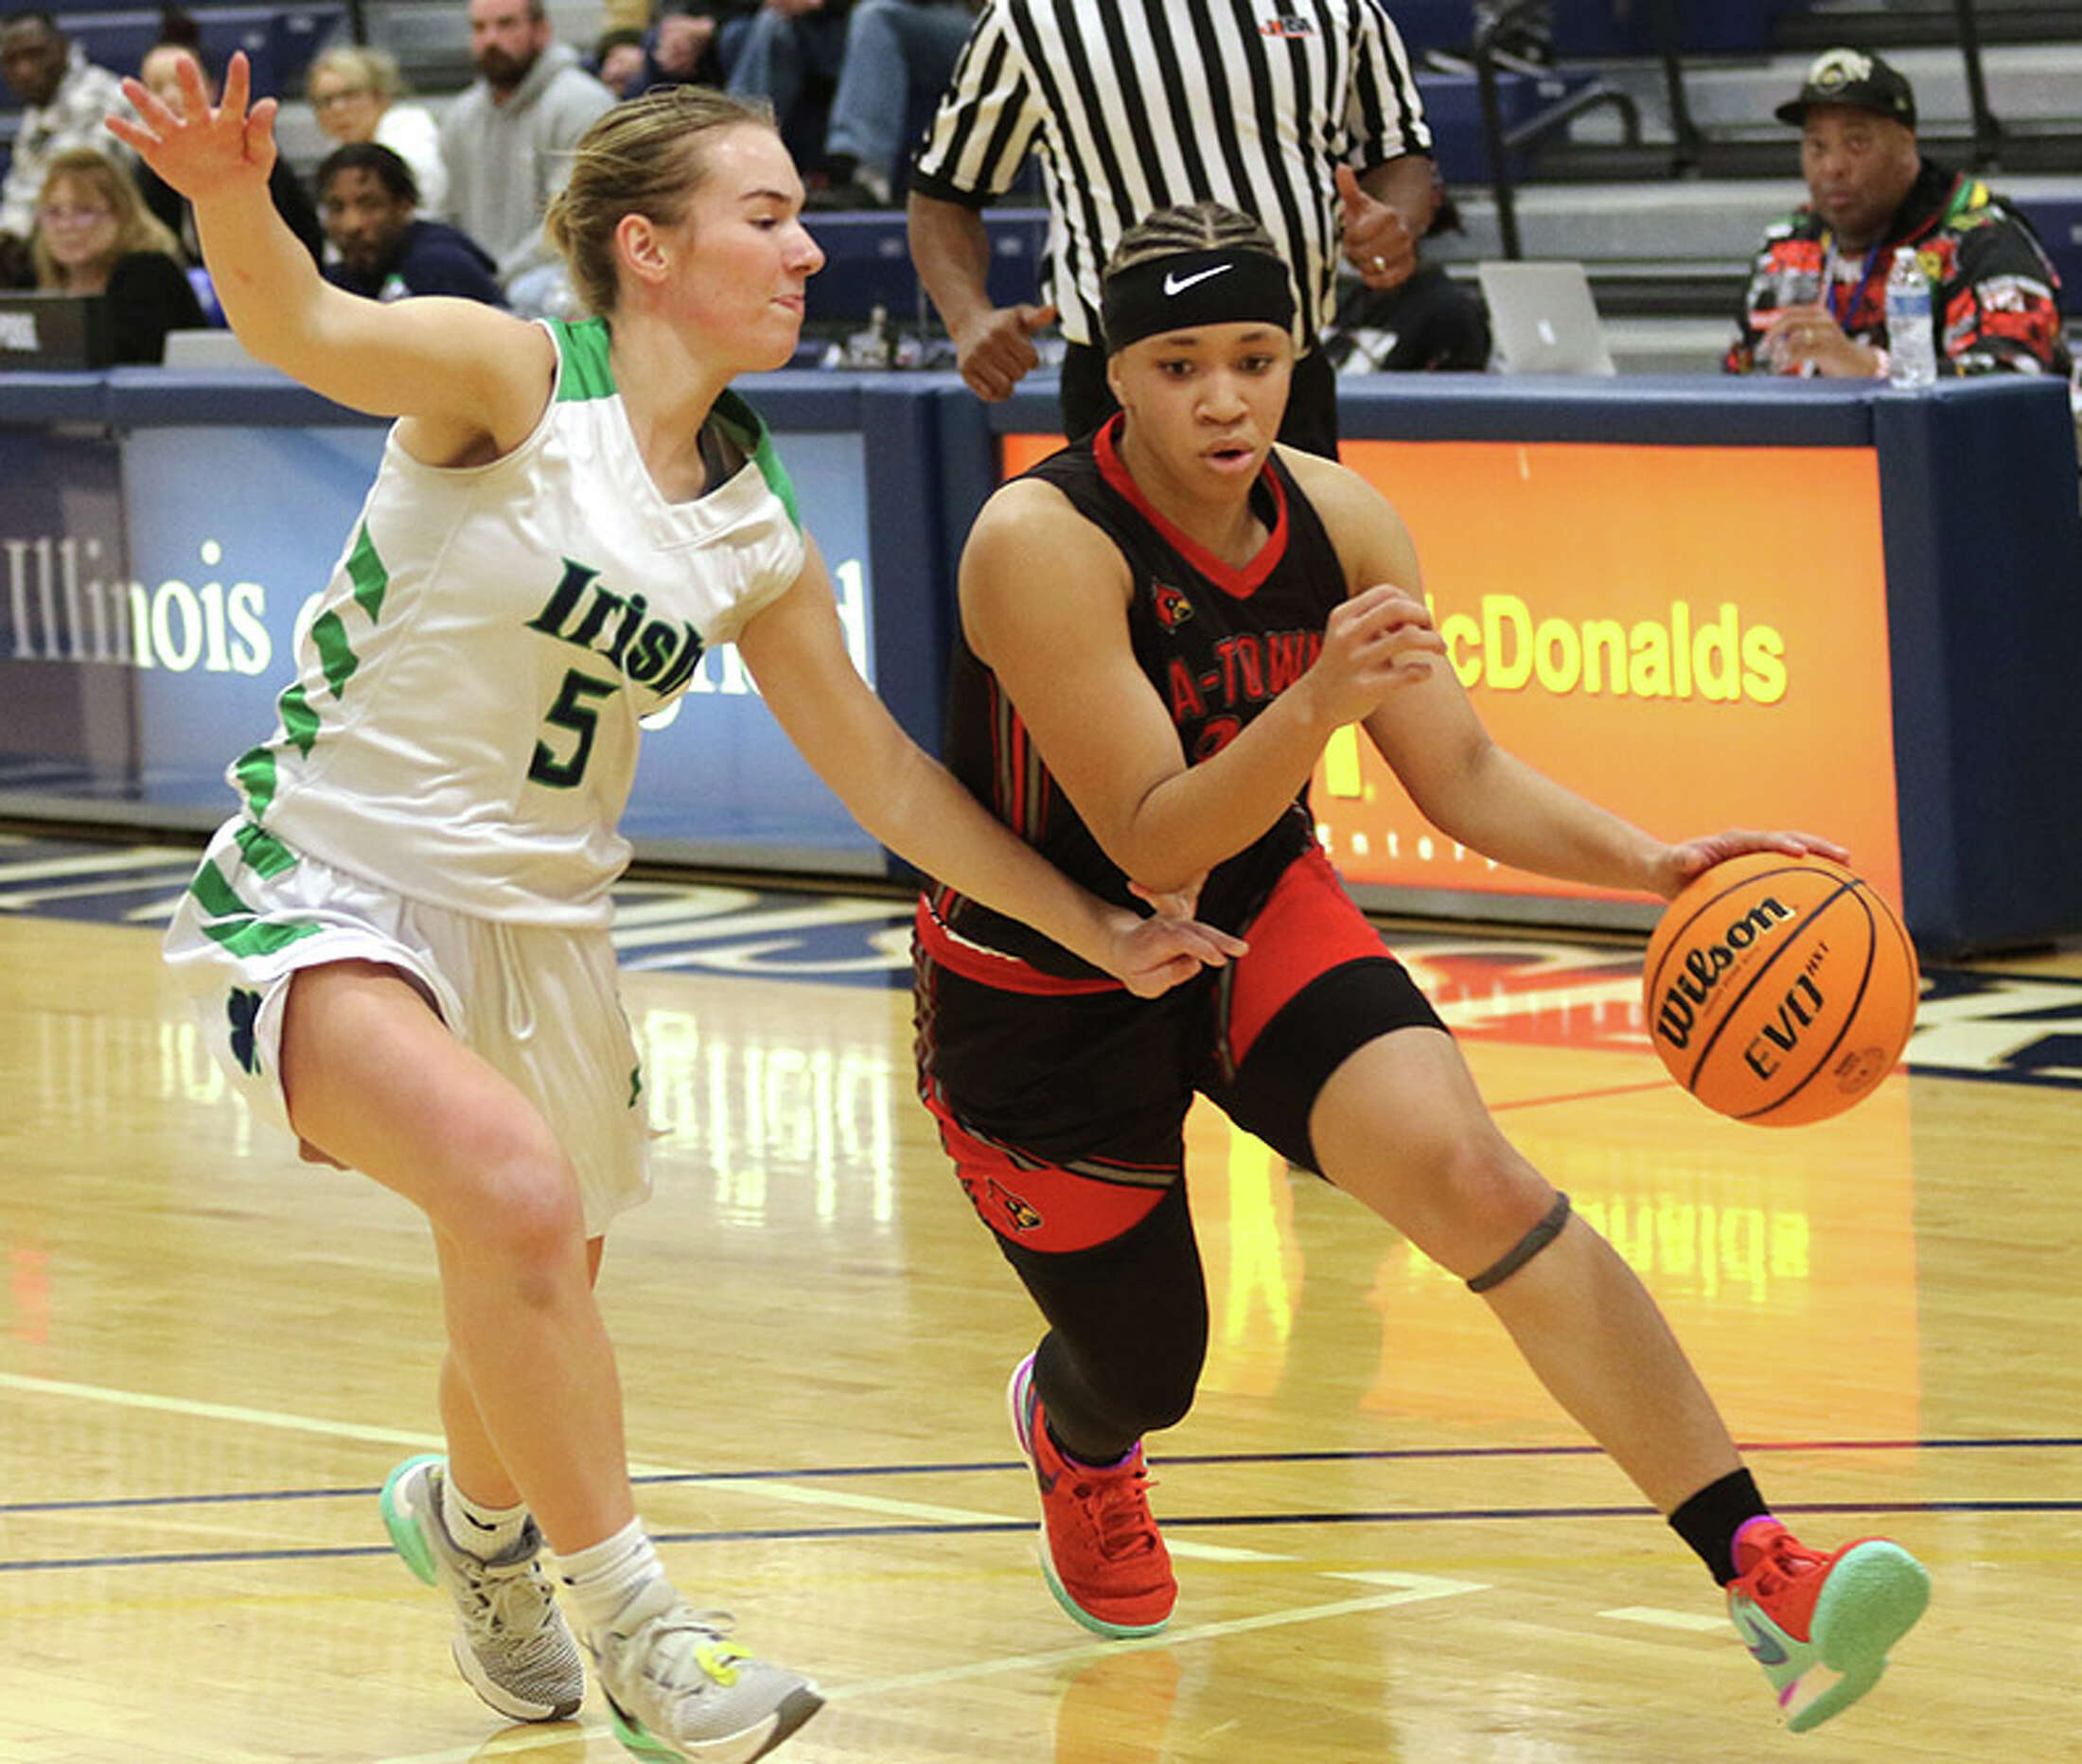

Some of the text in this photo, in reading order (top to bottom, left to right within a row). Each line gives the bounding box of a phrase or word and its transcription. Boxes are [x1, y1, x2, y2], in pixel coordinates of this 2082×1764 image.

[5, 538, 273, 676] Illinois
[1424, 592, 1788, 703] cDonalds
[527, 667, 622, 790] 5
[1657, 896, 1795, 1050] Wilson
[1744, 974, 1825, 1081] EVO
